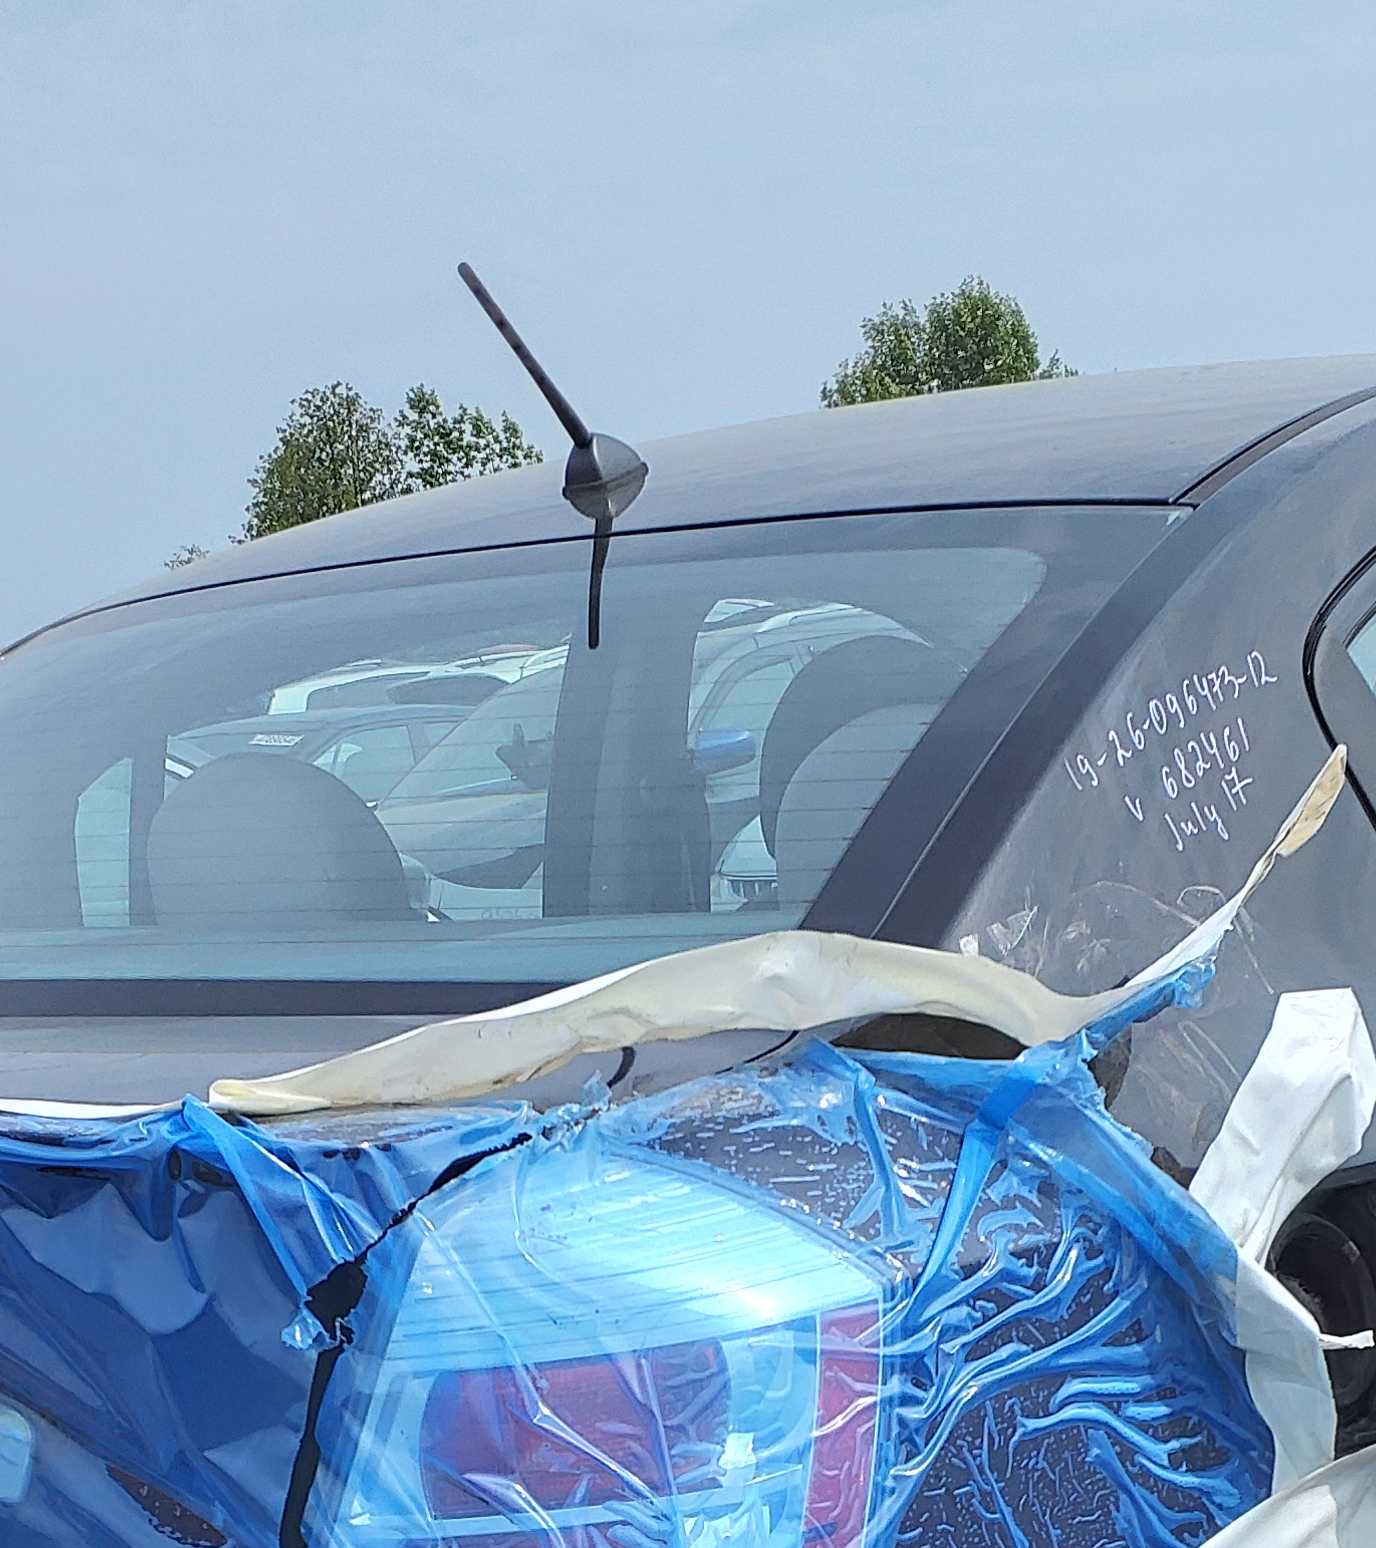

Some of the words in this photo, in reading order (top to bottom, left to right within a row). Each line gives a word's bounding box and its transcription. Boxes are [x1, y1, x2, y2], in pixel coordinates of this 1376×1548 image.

[1063, 650, 1278, 792] 19-26-096473-12
[1161, 717, 1250, 798] 682461
[1164, 802, 1229, 851] July
[1221, 766, 1253, 811] 17
